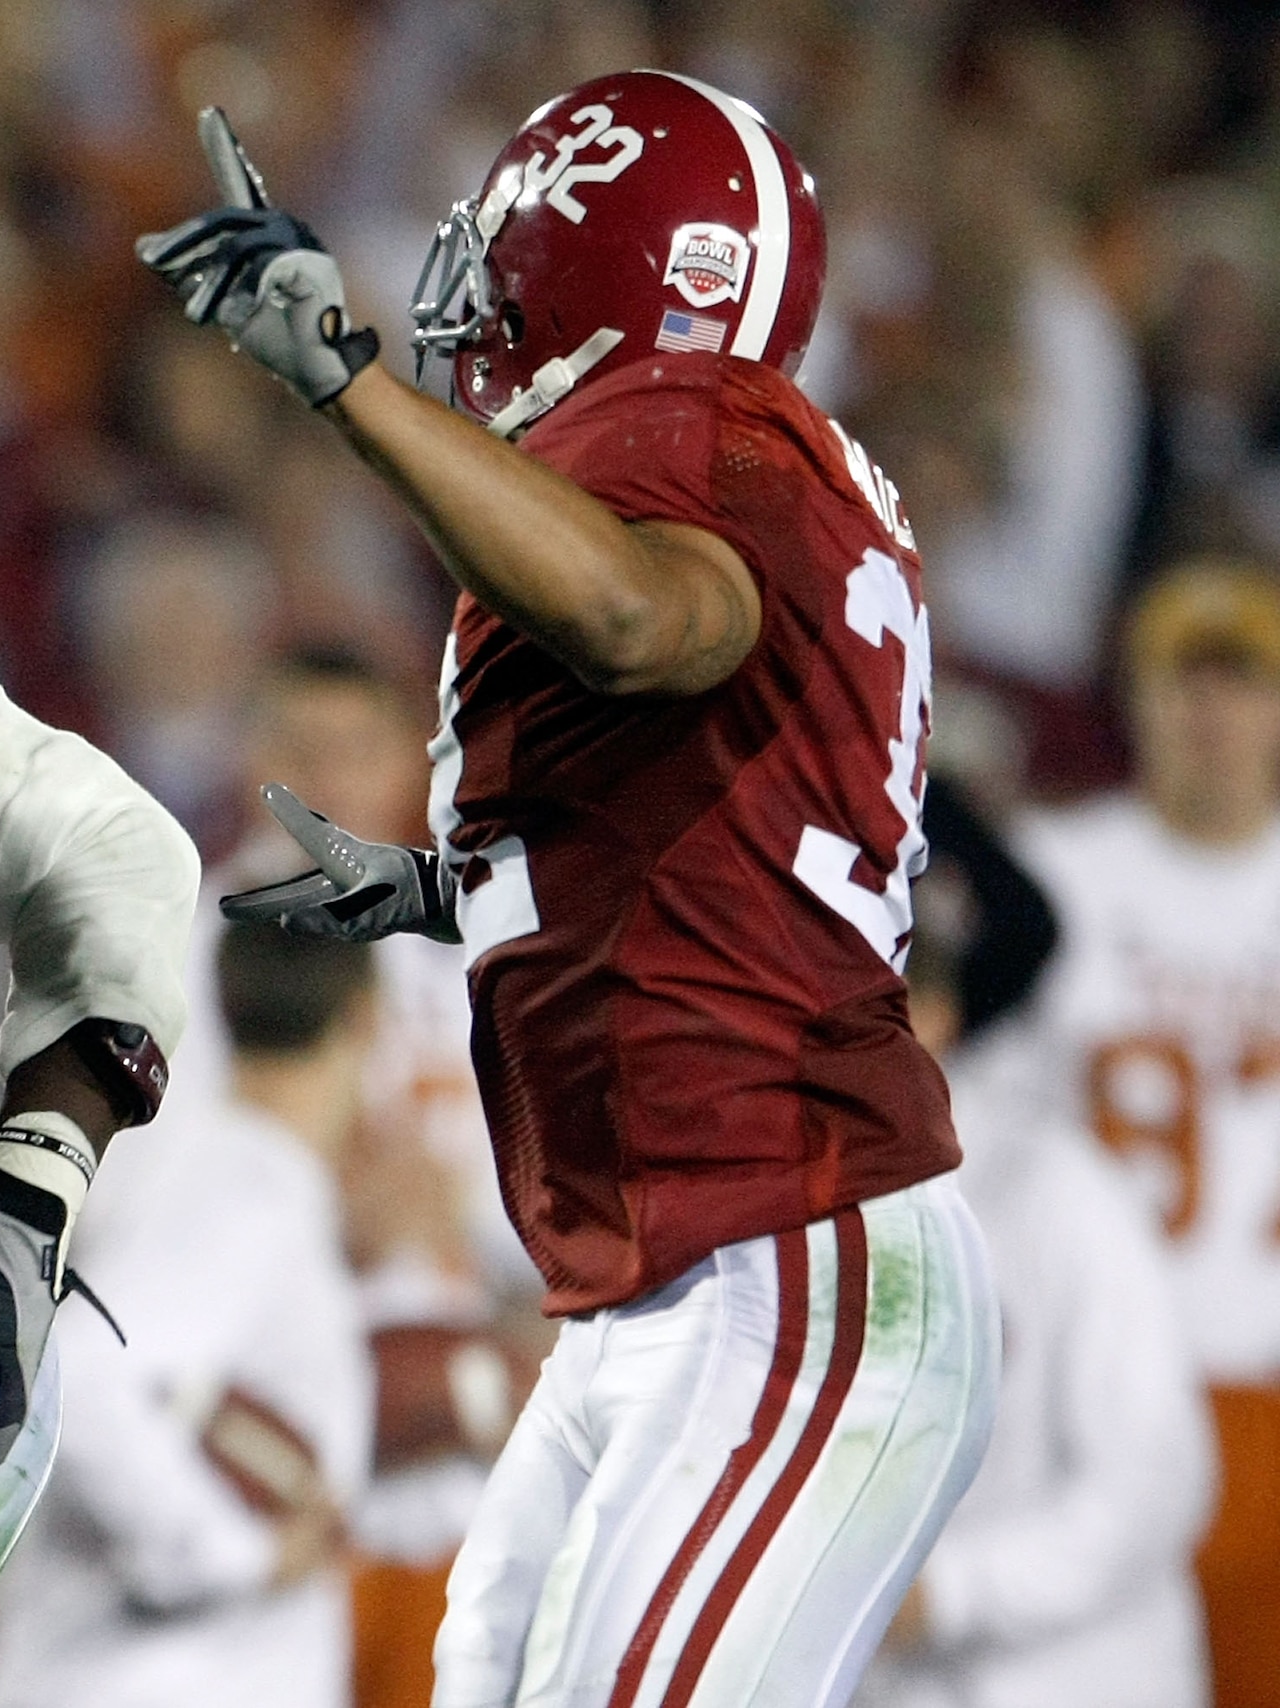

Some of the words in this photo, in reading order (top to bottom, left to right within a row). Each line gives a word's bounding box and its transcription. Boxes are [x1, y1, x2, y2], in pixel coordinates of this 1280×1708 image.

[525, 103, 644, 225] 32
[686, 240, 733, 265] BOWL
[793, 546, 932, 977] 3
